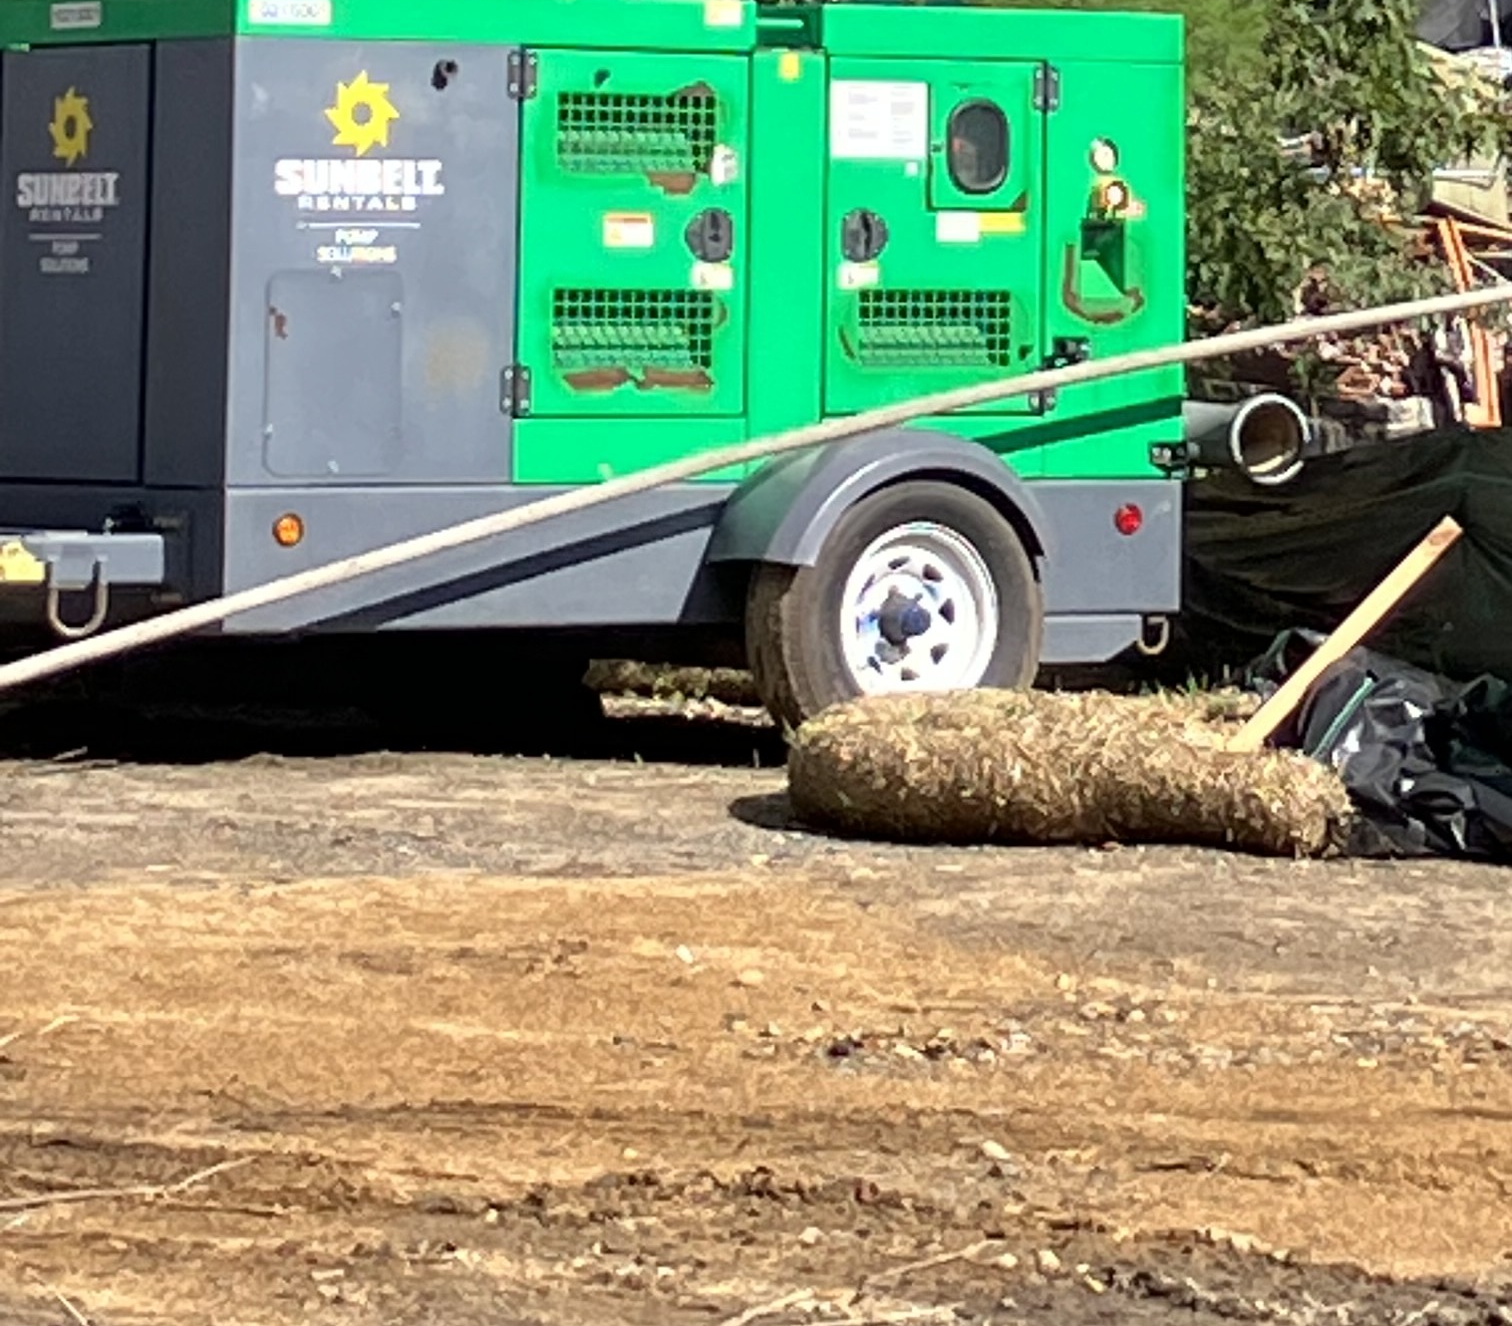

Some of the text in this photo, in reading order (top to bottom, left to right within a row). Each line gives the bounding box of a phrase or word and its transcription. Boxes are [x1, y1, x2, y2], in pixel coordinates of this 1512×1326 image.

[17, 173, 119, 207] SUNBELT
[274, 159, 444, 195] SUNBELT
[297, 196, 416, 211] RENTALS
